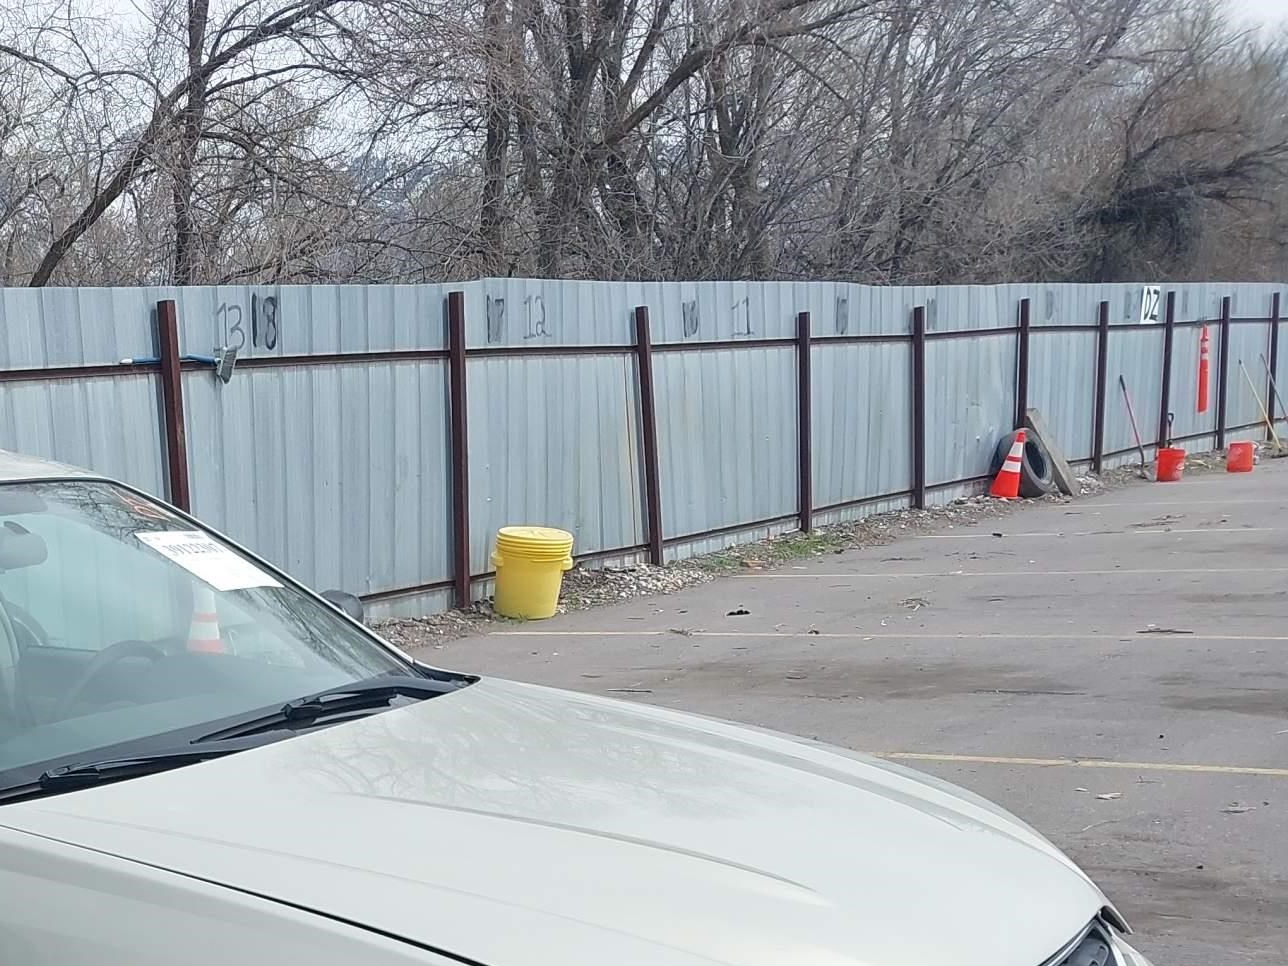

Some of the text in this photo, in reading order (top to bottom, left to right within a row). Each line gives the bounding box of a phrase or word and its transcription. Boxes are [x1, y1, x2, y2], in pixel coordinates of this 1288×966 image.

[216, 302, 245, 349] 13
[523, 295, 552, 339] 12
[731, 297, 754, 336] 11
